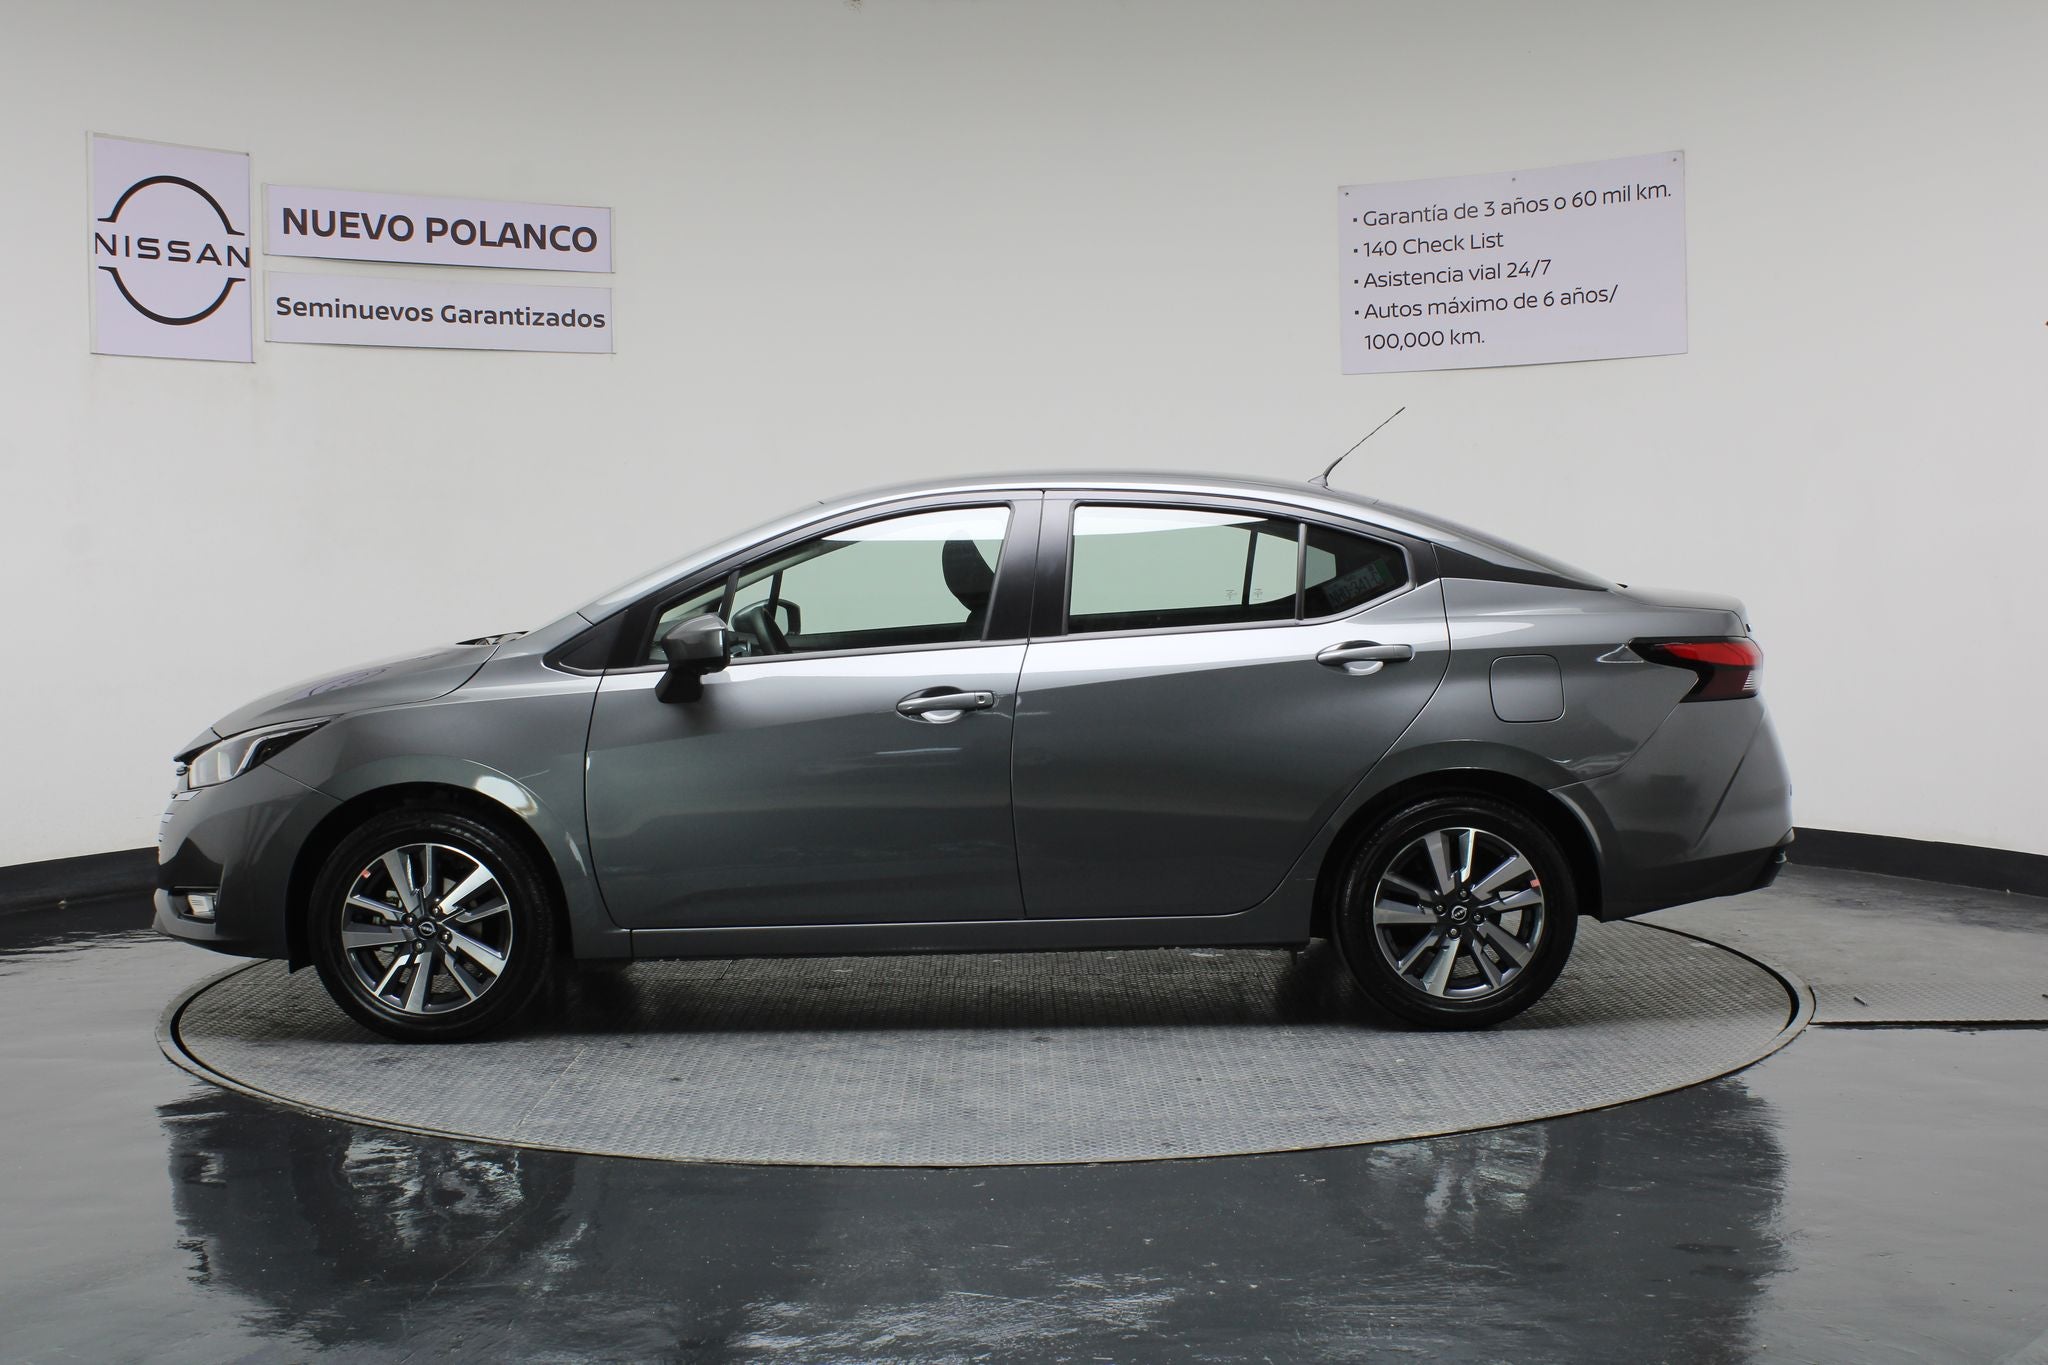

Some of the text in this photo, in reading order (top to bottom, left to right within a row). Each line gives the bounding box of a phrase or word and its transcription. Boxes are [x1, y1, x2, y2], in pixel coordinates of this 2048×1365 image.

[1362, 183, 1672, 227] Garantía de 3 años o 60 mil km.
[282, 207, 598, 254] NUEVO POLANCO
[1363, 232, 1505, 258] 140 Check List
[95, 231, 251, 269] NISSAN
[1363, 258, 1552, 289] Asistencia vial 24/7
[276, 295, 606, 329] Seminuevos Garantizados
[1363, 283, 1619, 320] Autos máximo de 6 años/
[1364, 328, 1485, 352] 100,000 km.
